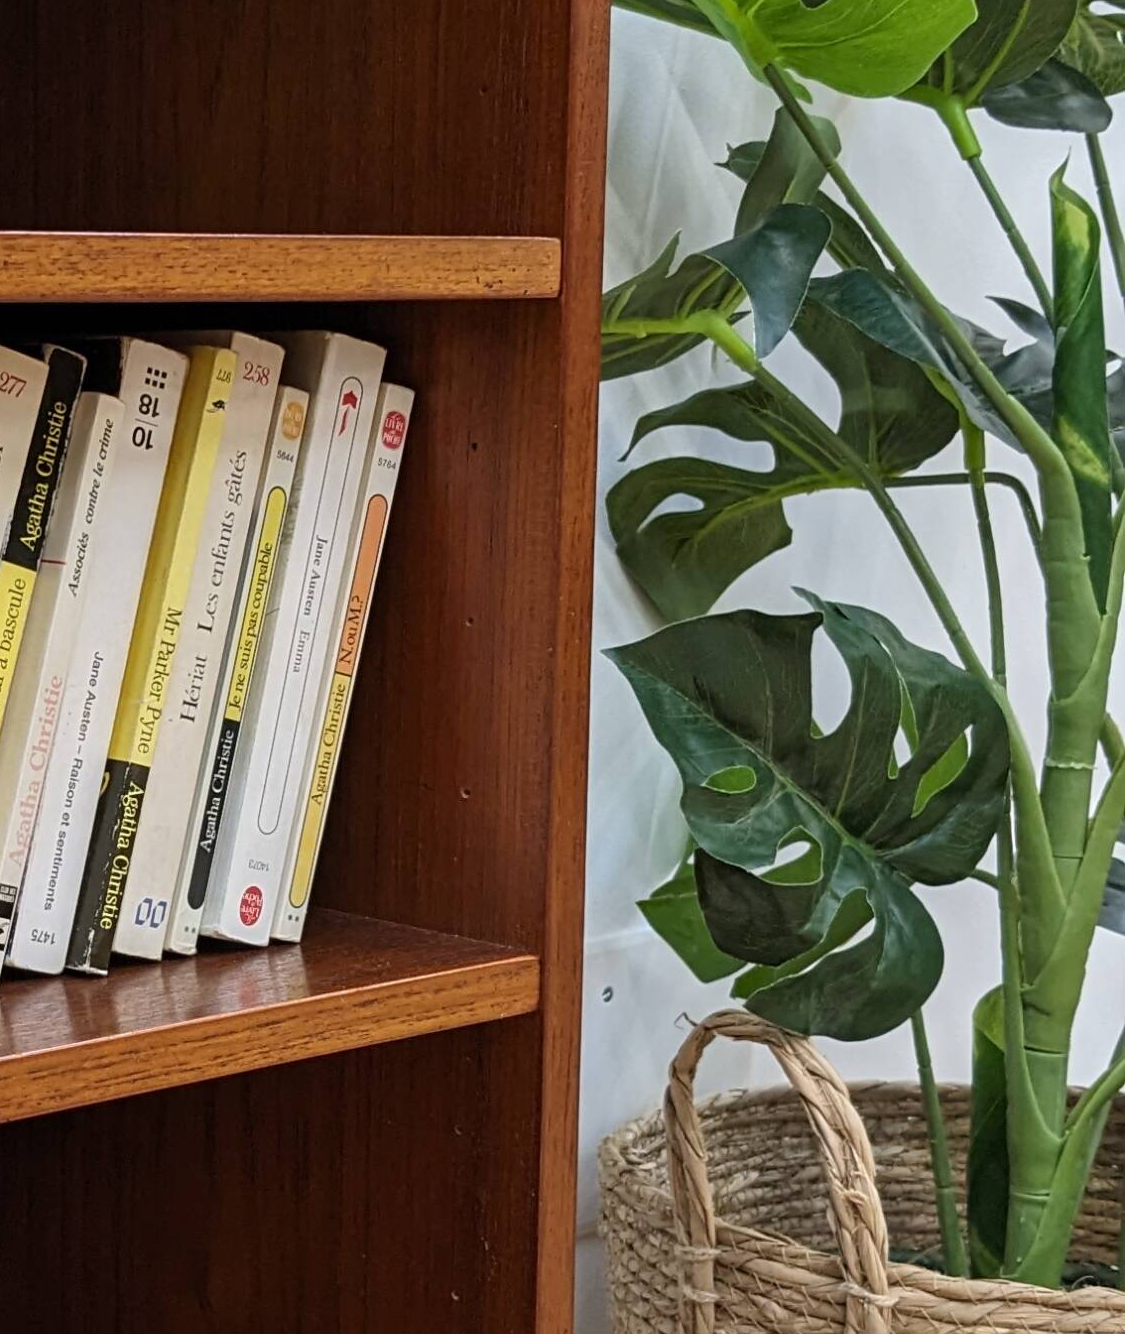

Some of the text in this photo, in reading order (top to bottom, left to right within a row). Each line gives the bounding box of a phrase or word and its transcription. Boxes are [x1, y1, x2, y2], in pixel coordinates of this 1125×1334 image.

[139, 393, 160, 418] 18
[243, 361, 270, 386] 258
[19, 401, 68, 552] Agatha Christie
[132, 426, 153, 450] 10
[68, 418, 114, 597] Associés contre le crime
[179, 450, 247, 723] Hériat Les enfants gâtés
[228, 542, 273, 712] Je ne suis pas coupable
[293, 535, 328, 673] Jane Austen Emma
[79, 690, 97, 742] Austen
[90, 651, 105, 688] Jane
[137, 606, 184, 754] Mr Parker Pyne
[9, 675, 63, 867] Agatha Christie
[64, 758, 84, 809] Raison
[199, 729, 235, 854] Agatha Christie
[311, 684, 346, 805] Agatha Christie
[44, 830, 67, 912] sentiments
[61, 811, 72, 827] et
[99, 781, 145, 931] Agatha Christie
[31, 928, 56, 945] 1475
